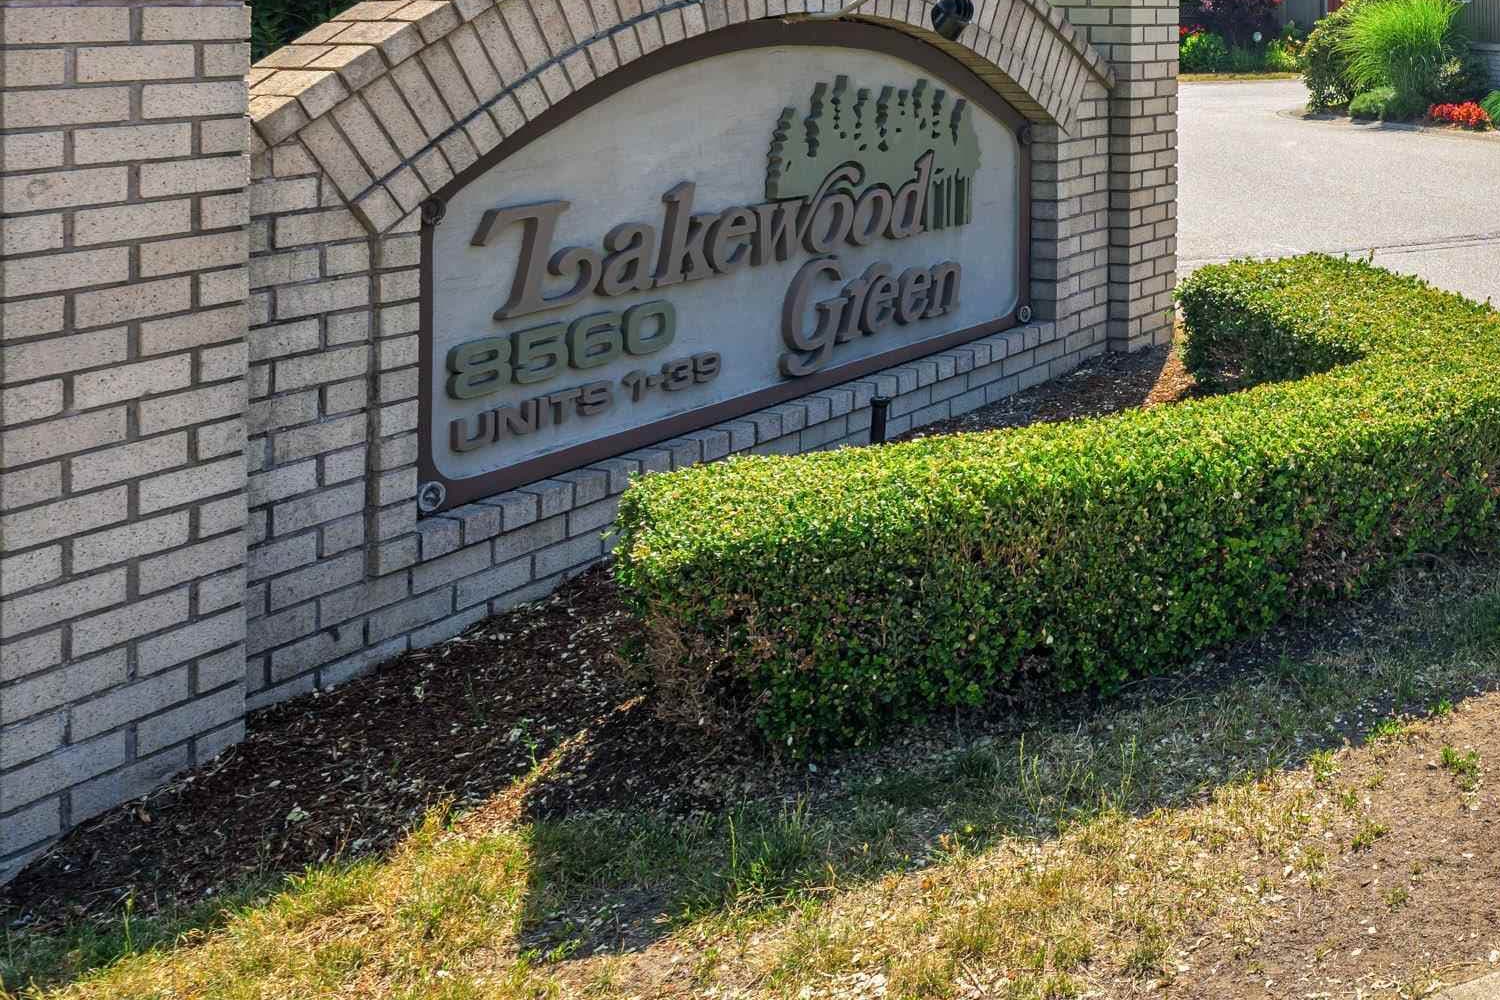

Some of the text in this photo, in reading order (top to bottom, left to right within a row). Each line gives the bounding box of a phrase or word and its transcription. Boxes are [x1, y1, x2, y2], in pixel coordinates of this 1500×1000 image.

[470, 149, 935, 322] Lakewood
[445, 300, 677, 400] 8560
[779, 254, 963, 378] Green
[449, 351, 722, 454] UNITS 1-39
